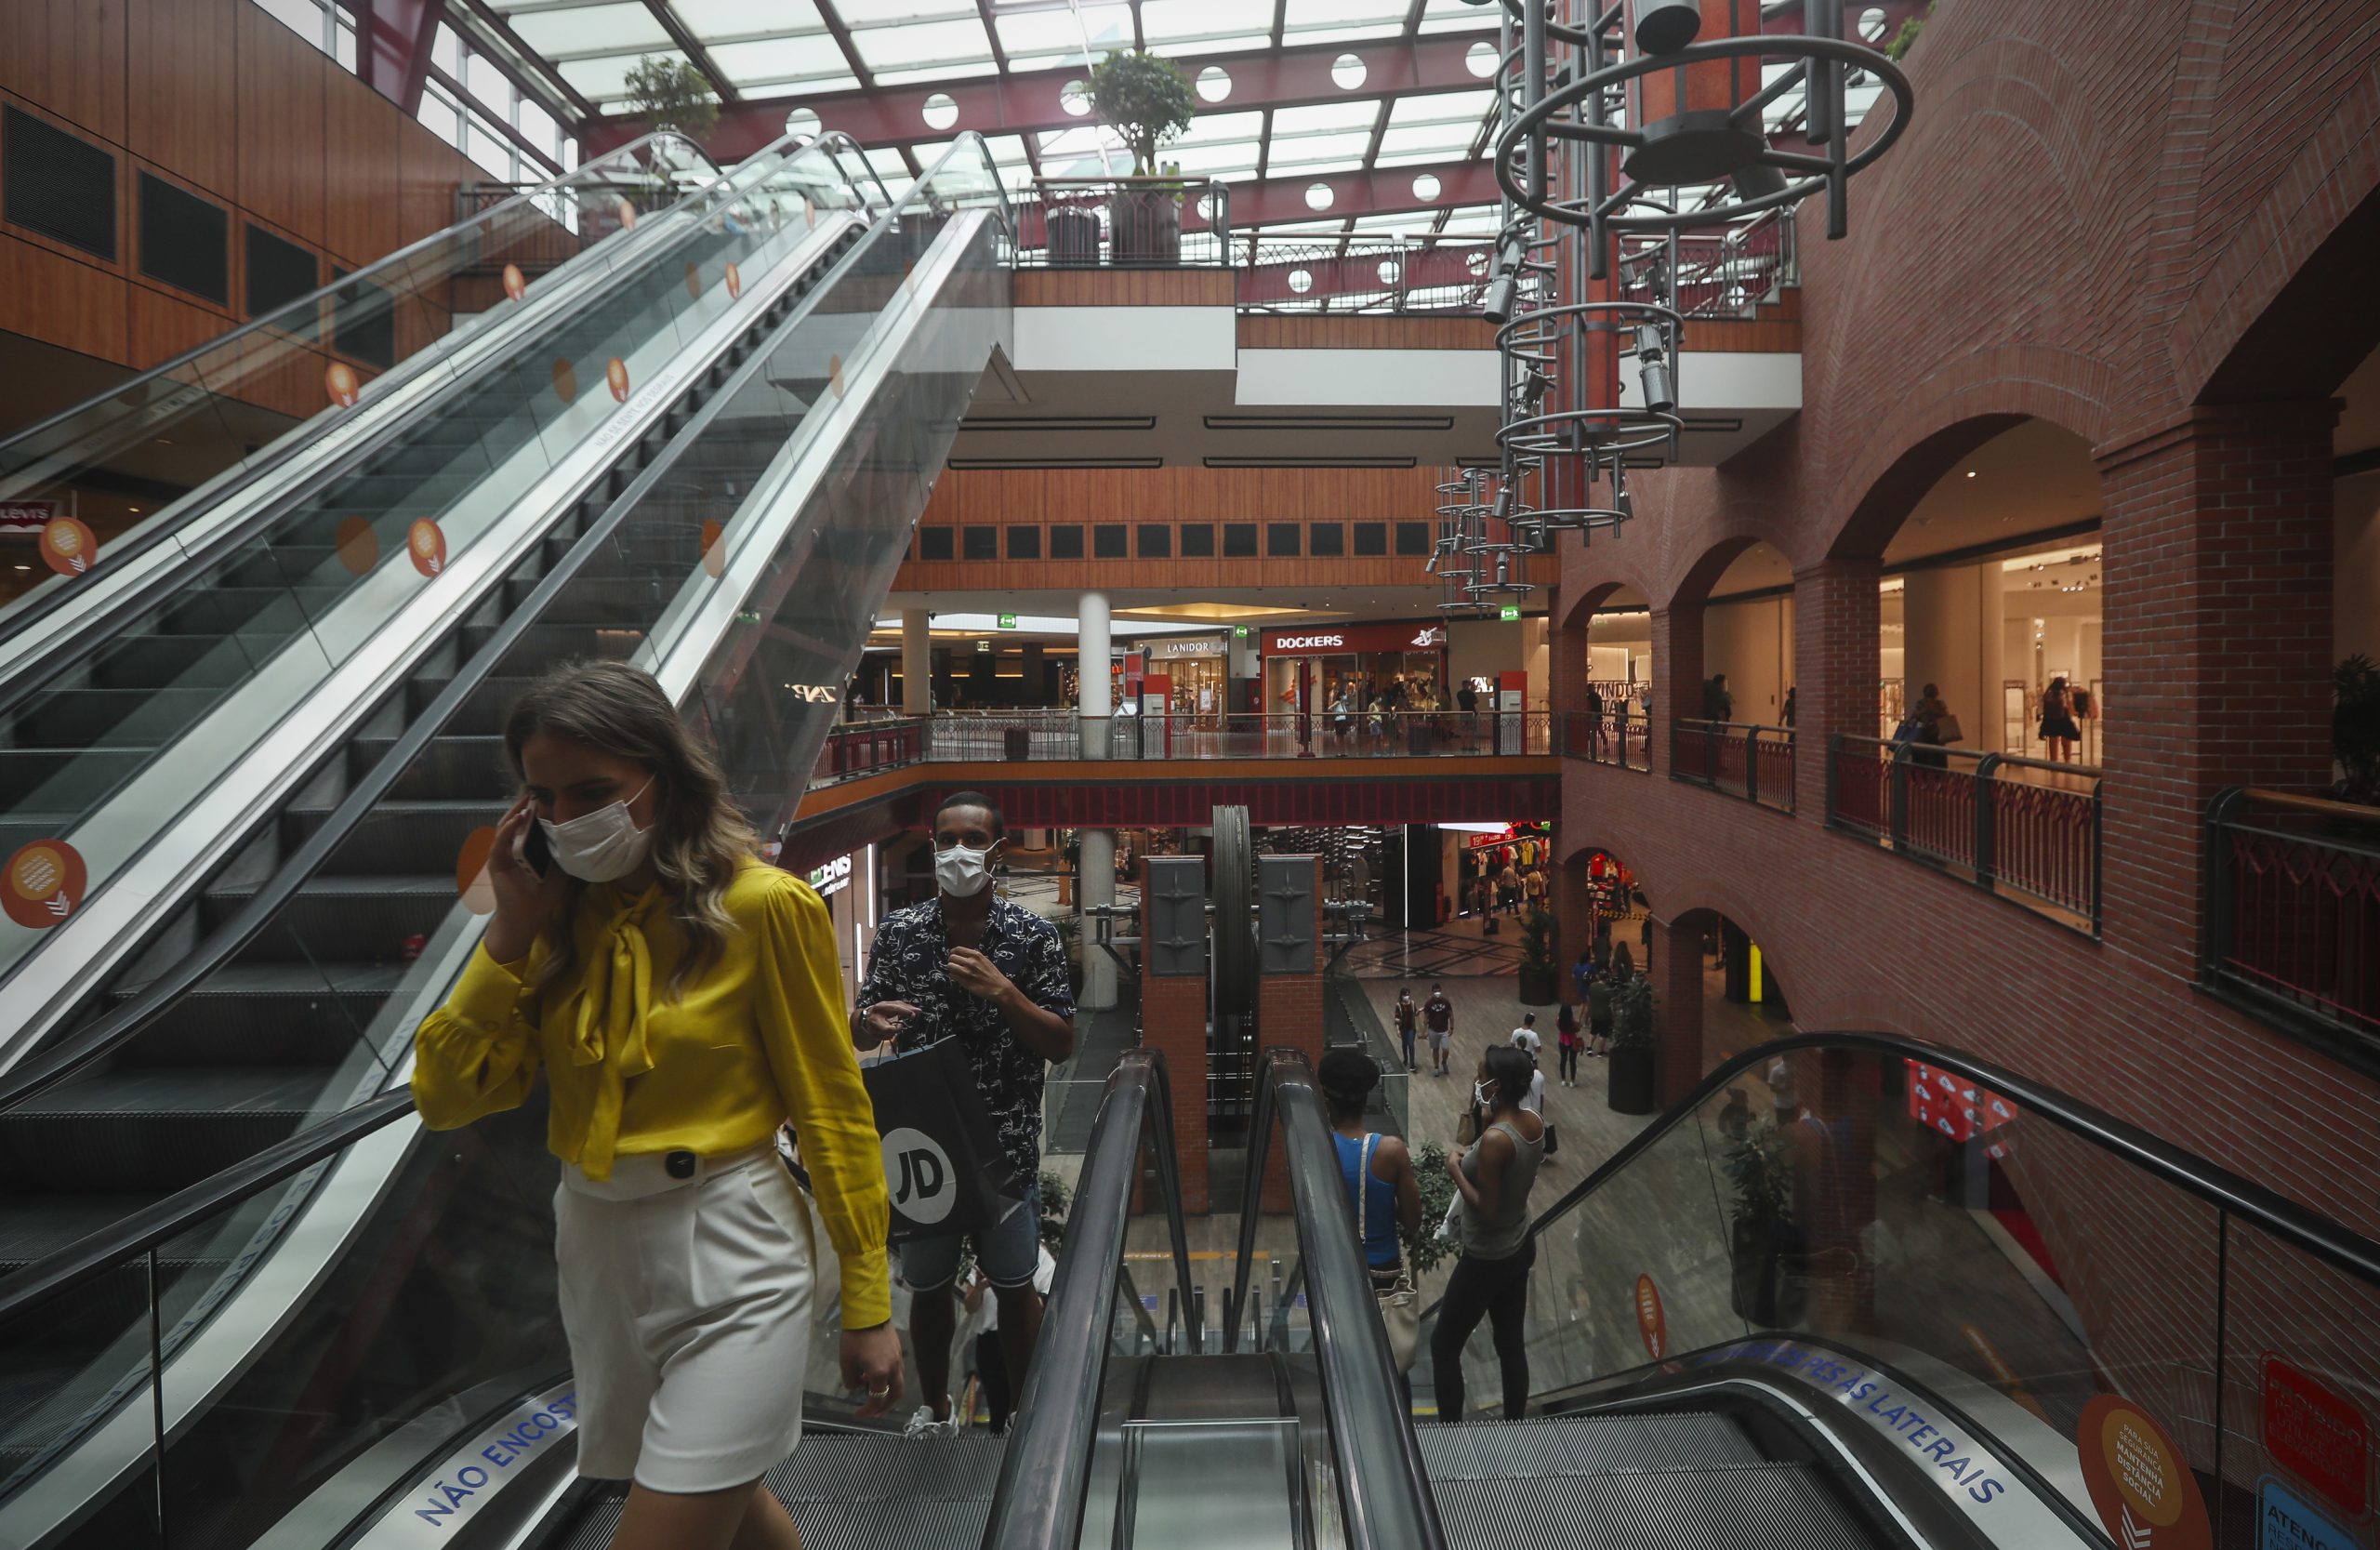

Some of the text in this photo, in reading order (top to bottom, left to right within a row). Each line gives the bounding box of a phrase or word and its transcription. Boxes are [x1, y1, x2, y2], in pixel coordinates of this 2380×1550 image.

[1167, 643, 1209, 653] LANIDOR
[1276, 635, 1343, 649] DOCKERS
[895, 1148, 944, 1205] JD
[1801, 1356, 1846, 1384] PÉS
[1839, 1371, 1877, 1400] ÀS
[1868, 1394, 2005, 1504] LATERAIS
[2123, 1424, 2160, 1460] PARA SUA
[2116, 1440, 2164, 1489] MANTENHA
[2117, 1453, 2162, 1501] DISTÂNCIA
[415, 1466, 489, 1527] NÃO
